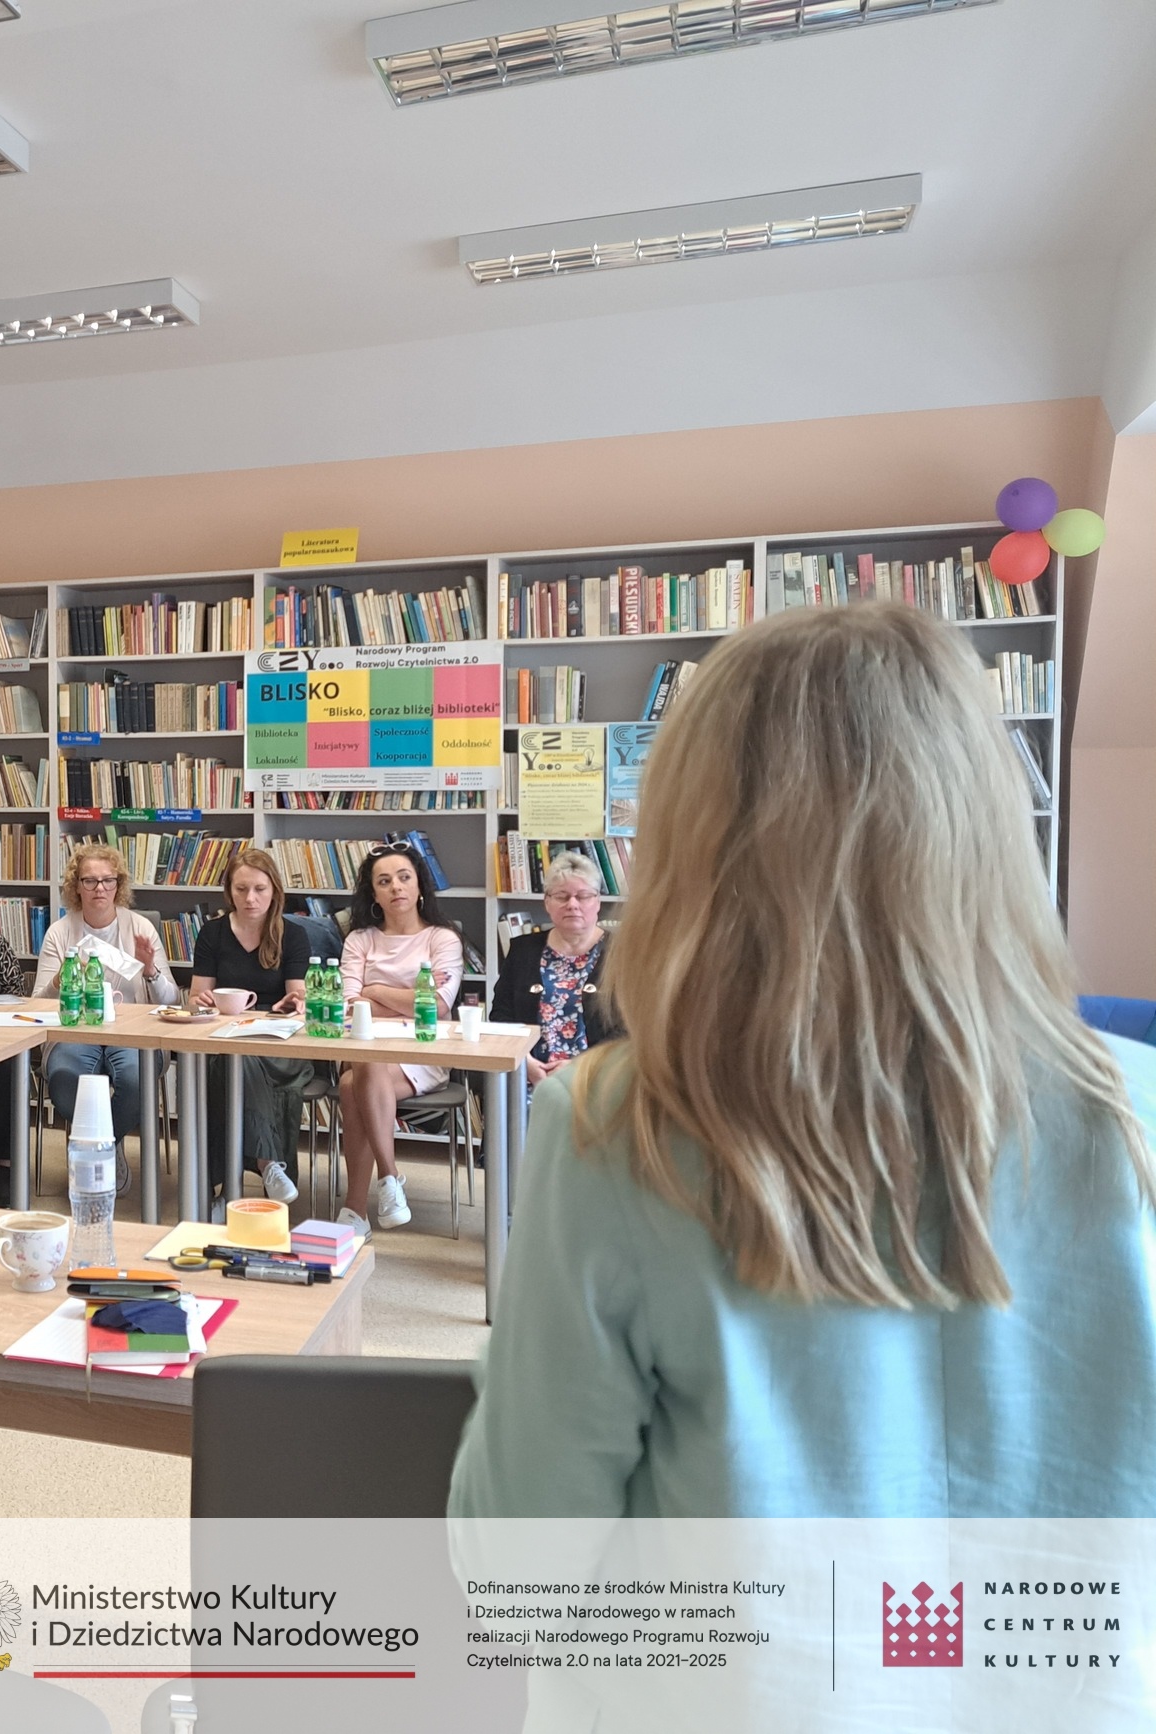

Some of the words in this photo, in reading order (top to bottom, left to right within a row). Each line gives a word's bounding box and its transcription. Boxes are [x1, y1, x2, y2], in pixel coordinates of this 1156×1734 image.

[301, 538, 340, 548] Literatura
[283, 546, 355, 558] popularnonaukowa
[733, 573, 742, 609] STALIN
[625, 567, 638, 635] PIŁSUDSKI
[355, 646, 403, 657] Narodowy
[405, 644, 446, 656] Program
[355, 659, 396, 670] Rozwoju
[398, 657, 461, 669] Czytelnictwa
[463, 656, 479, 664] 2.0
[260, 682, 340, 702] BLISKO
[654, 683, 669, 712] WAJDA
[369, 706, 400, 716] coraz
[403, 704, 434, 718] bliżej
[254, 728, 299, 738] Biblioteka
[374, 726, 429, 739] Społeczność
[314, 741, 359, 752] Inicjatywy
[441, 739, 492, 750] Oddolność
[255, 754, 299, 765] Lokalność
[376, 752, 427, 762] Kooporacja
[508, 834, 516, 867] HISTORIA
